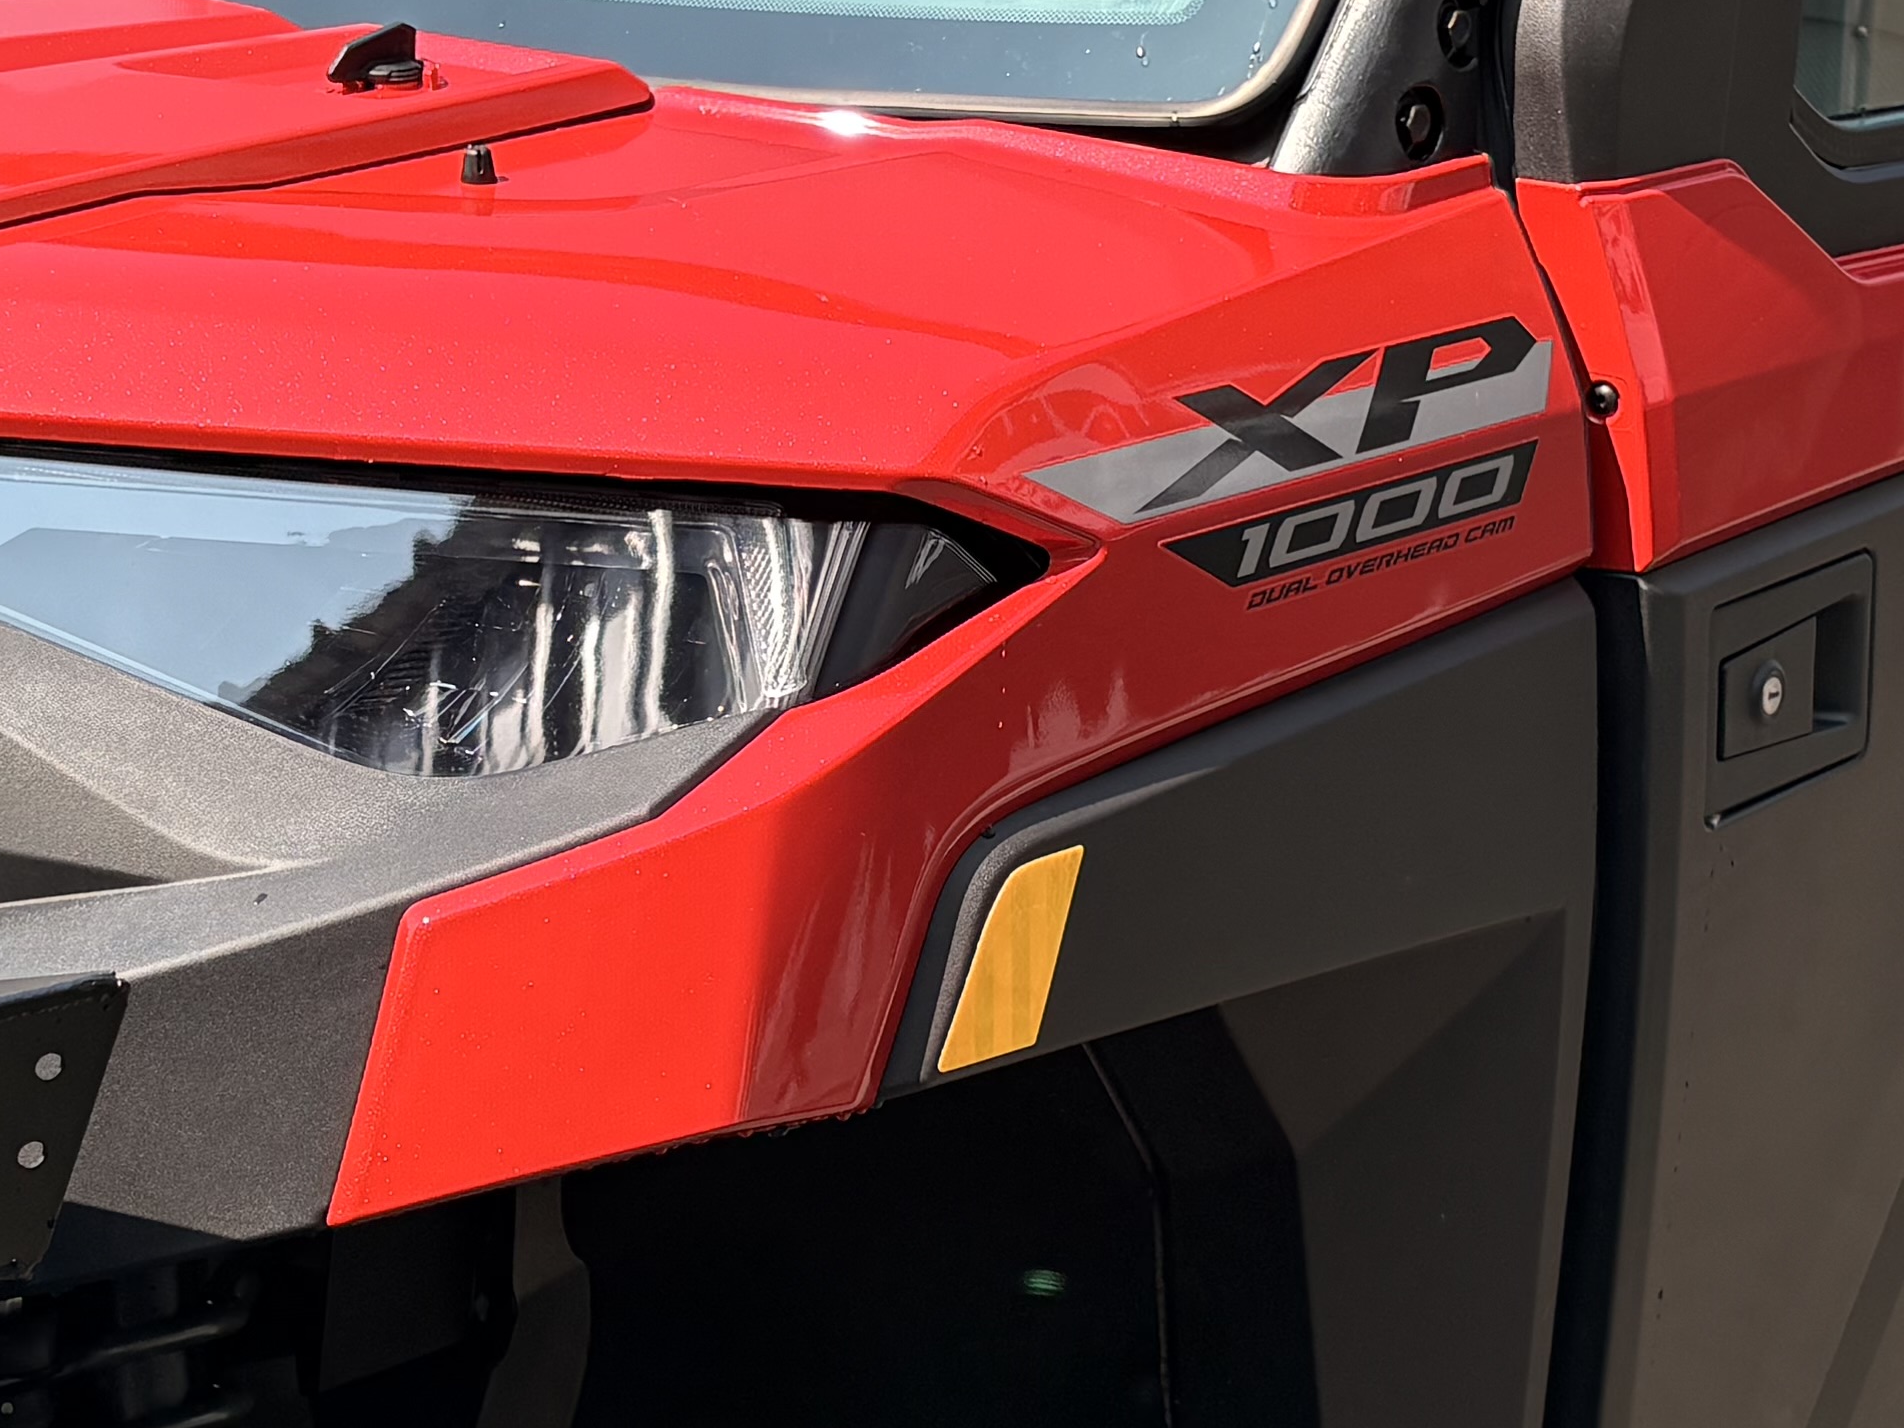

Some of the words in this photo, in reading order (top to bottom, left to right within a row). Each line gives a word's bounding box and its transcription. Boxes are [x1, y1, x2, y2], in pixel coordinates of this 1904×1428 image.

[1134, 315, 1537, 513] XP
[1236, 453, 1516, 579] 1000
[1246, 576, 1318, 611] DUAL
[1324, 532, 1461, 587] OVERHEAD
[1463, 515, 1516, 544] CAM
